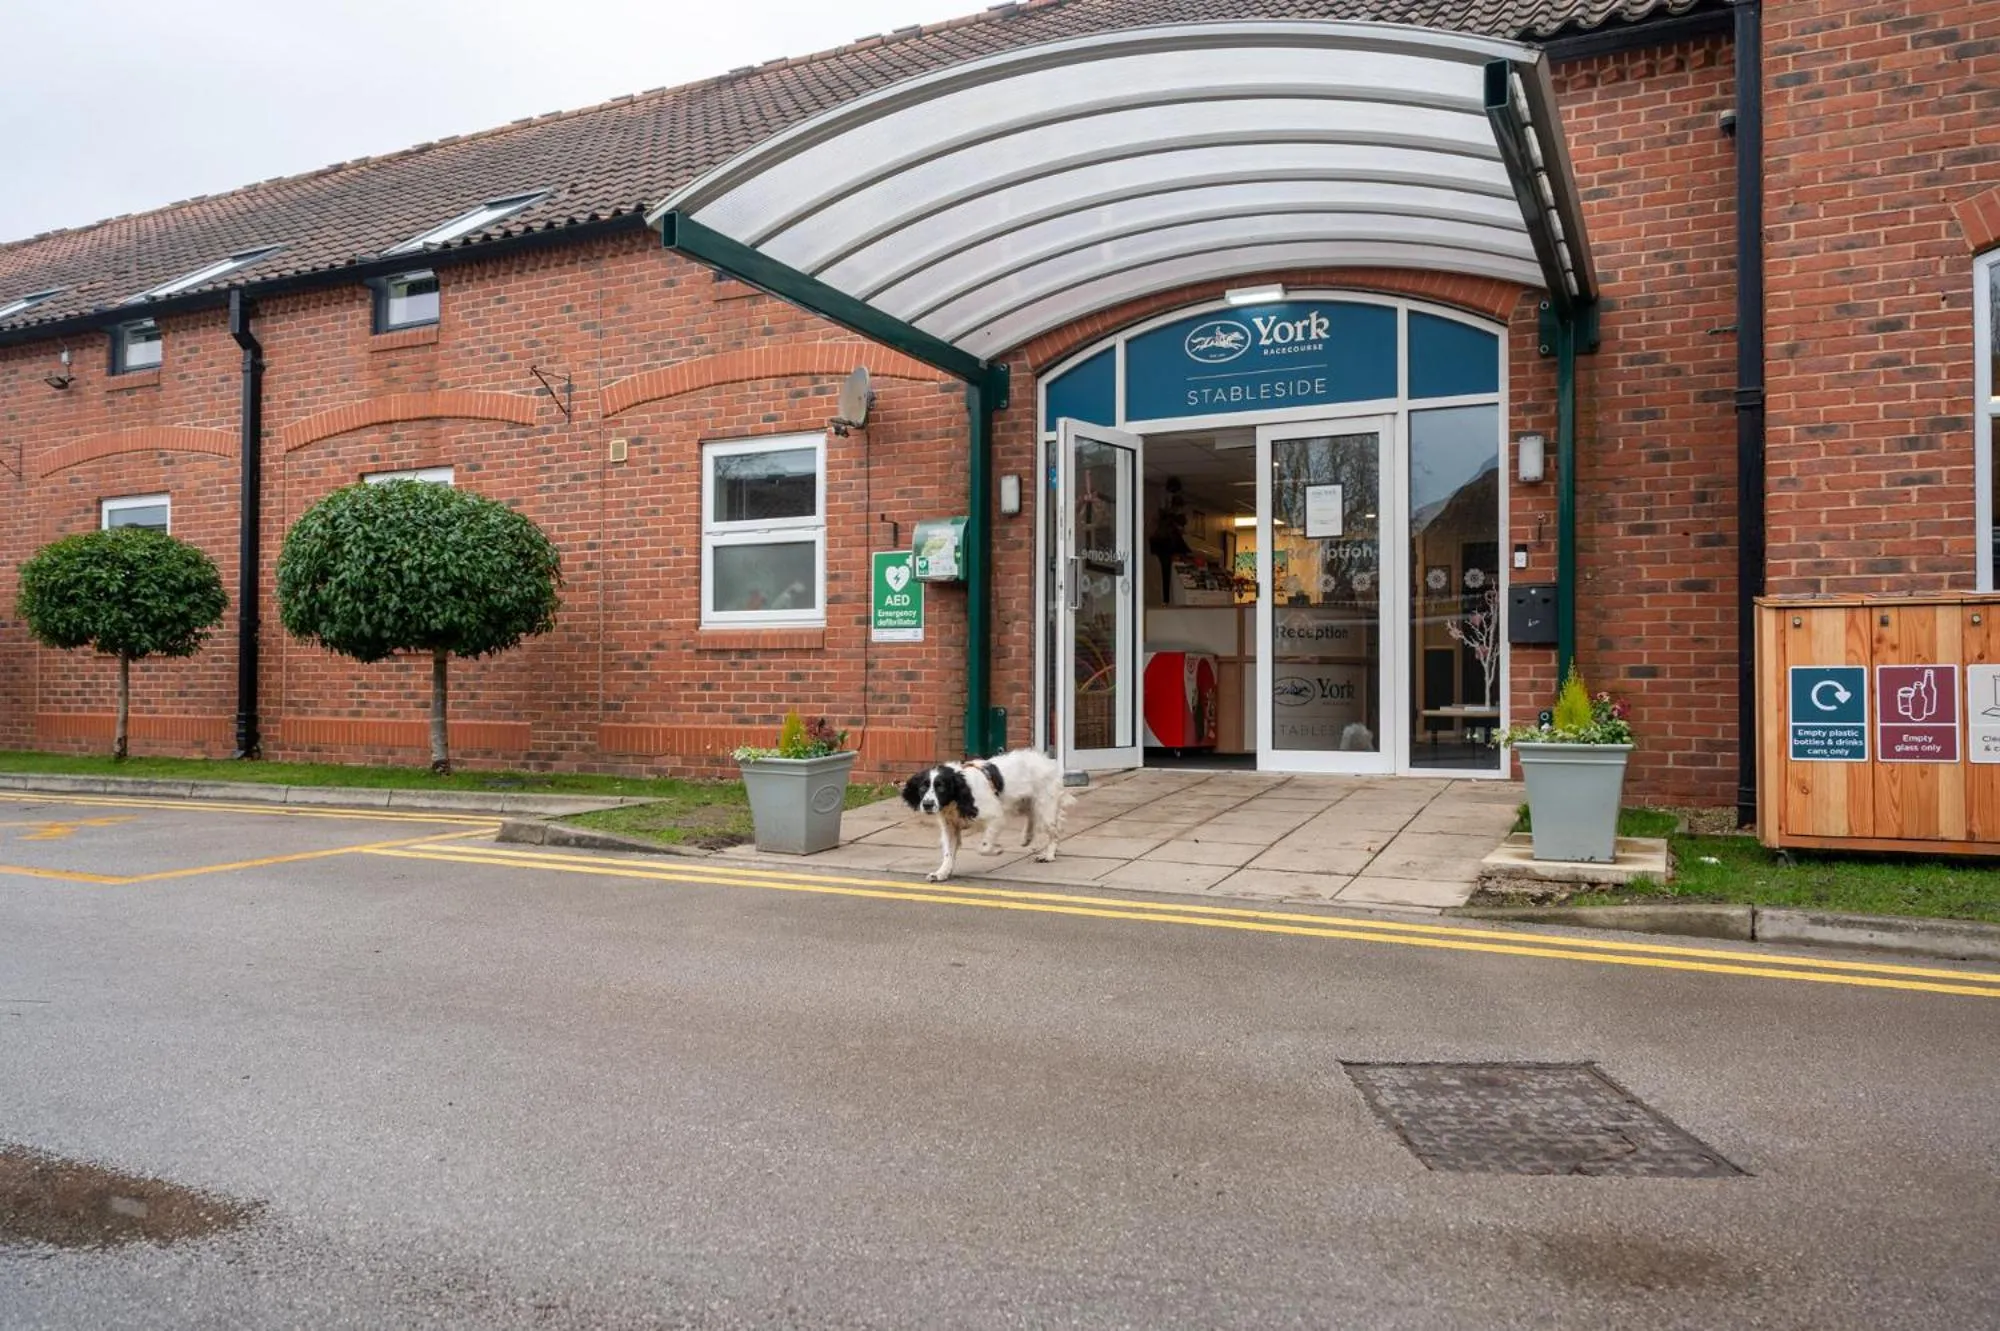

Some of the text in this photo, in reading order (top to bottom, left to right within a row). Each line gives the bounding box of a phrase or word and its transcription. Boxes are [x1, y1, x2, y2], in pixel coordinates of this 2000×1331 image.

[1252, 310, 1331, 345] York
[1263, 344, 1324, 356] RACECOURSE
[1187, 378, 1328, 406] STABLESIDE
[884, 594, 910, 606] AED
[877, 609, 917, 618] Emergency
[1275, 625, 1349, 640] Reception
[1316, 678, 1356, 699] York
[1798, 729, 1859, 737] Empty plastic
[1902, 734, 1933, 743] Empty
[1793, 738, 1825, 746] bottles
[1835, 738, 1864, 746] drinks
[1829, 748, 1850, 756] only
[1894, 743, 1942, 753] glass only
